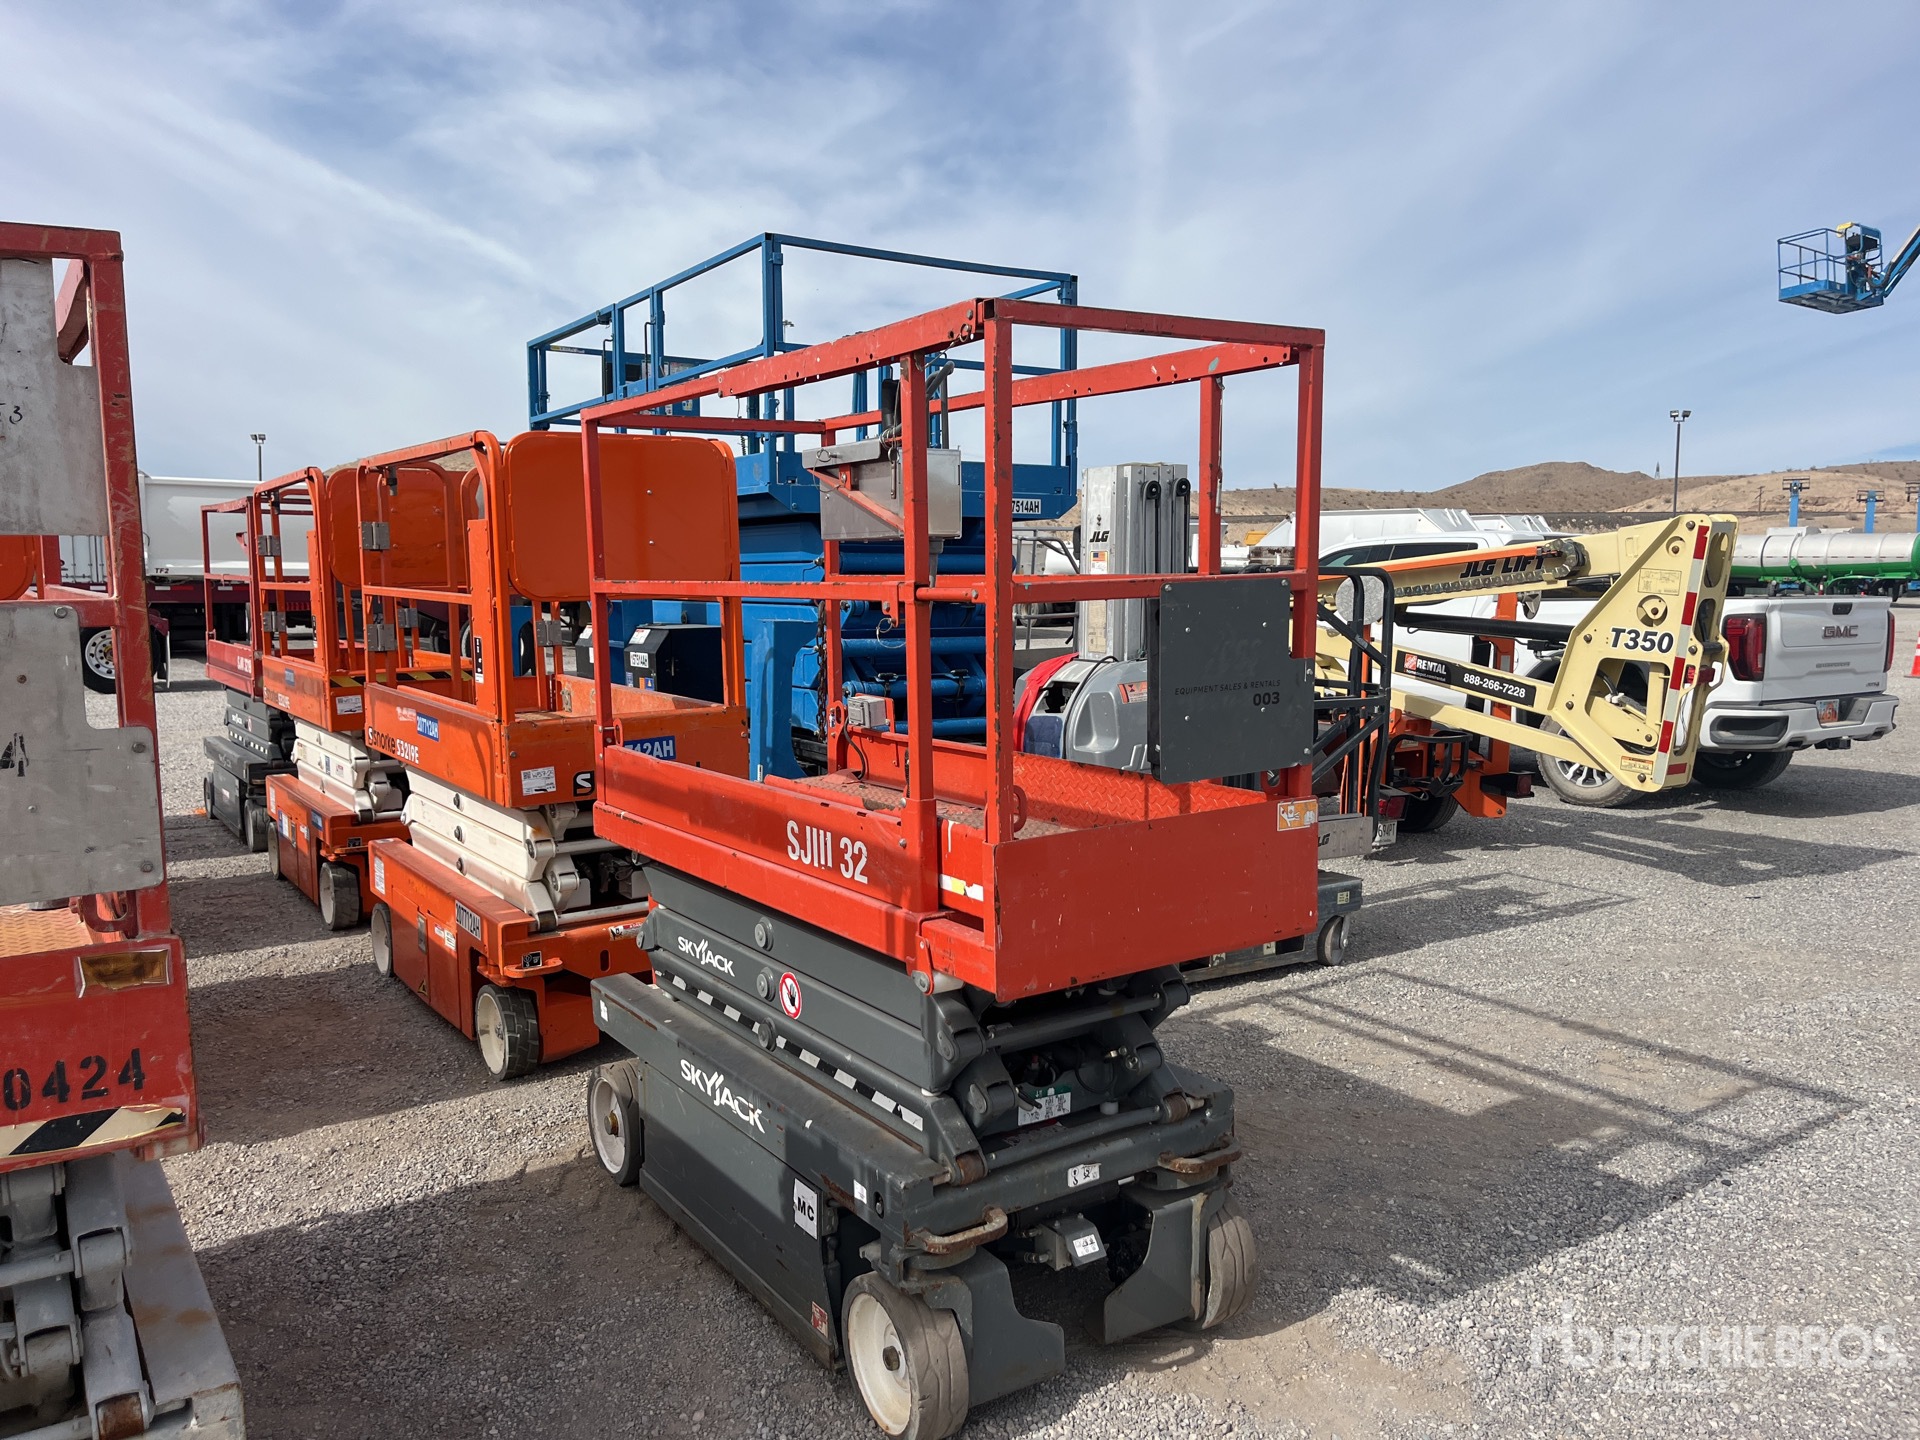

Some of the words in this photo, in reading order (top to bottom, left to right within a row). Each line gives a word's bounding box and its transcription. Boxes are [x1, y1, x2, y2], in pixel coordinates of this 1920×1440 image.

[1089, 530, 1110, 543] JLG
[1460, 559, 1497, 578] JLG
[1611, 627, 1674, 654] T350
[1822, 624, 1859, 640] GMC
[1416, 659, 1447, 675] RENTAL
[1174, 685, 1218, 696] EQUIPMENT
[1219, 682, 1242, 692] SALES
[1243, 682, 1248, 690] &
[1250, 680, 1281, 689] RENTALS
[1463, 673, 1526, 698] 888-266-7228
[1252, 692, 1280, 706] 003
[840, 836, 868, 884] 32
[677, 936, 736, 978] SKYJACK
[680, 1058, 766, 1134] SKYJACK
[797, 1196, 815, 1222] MC
